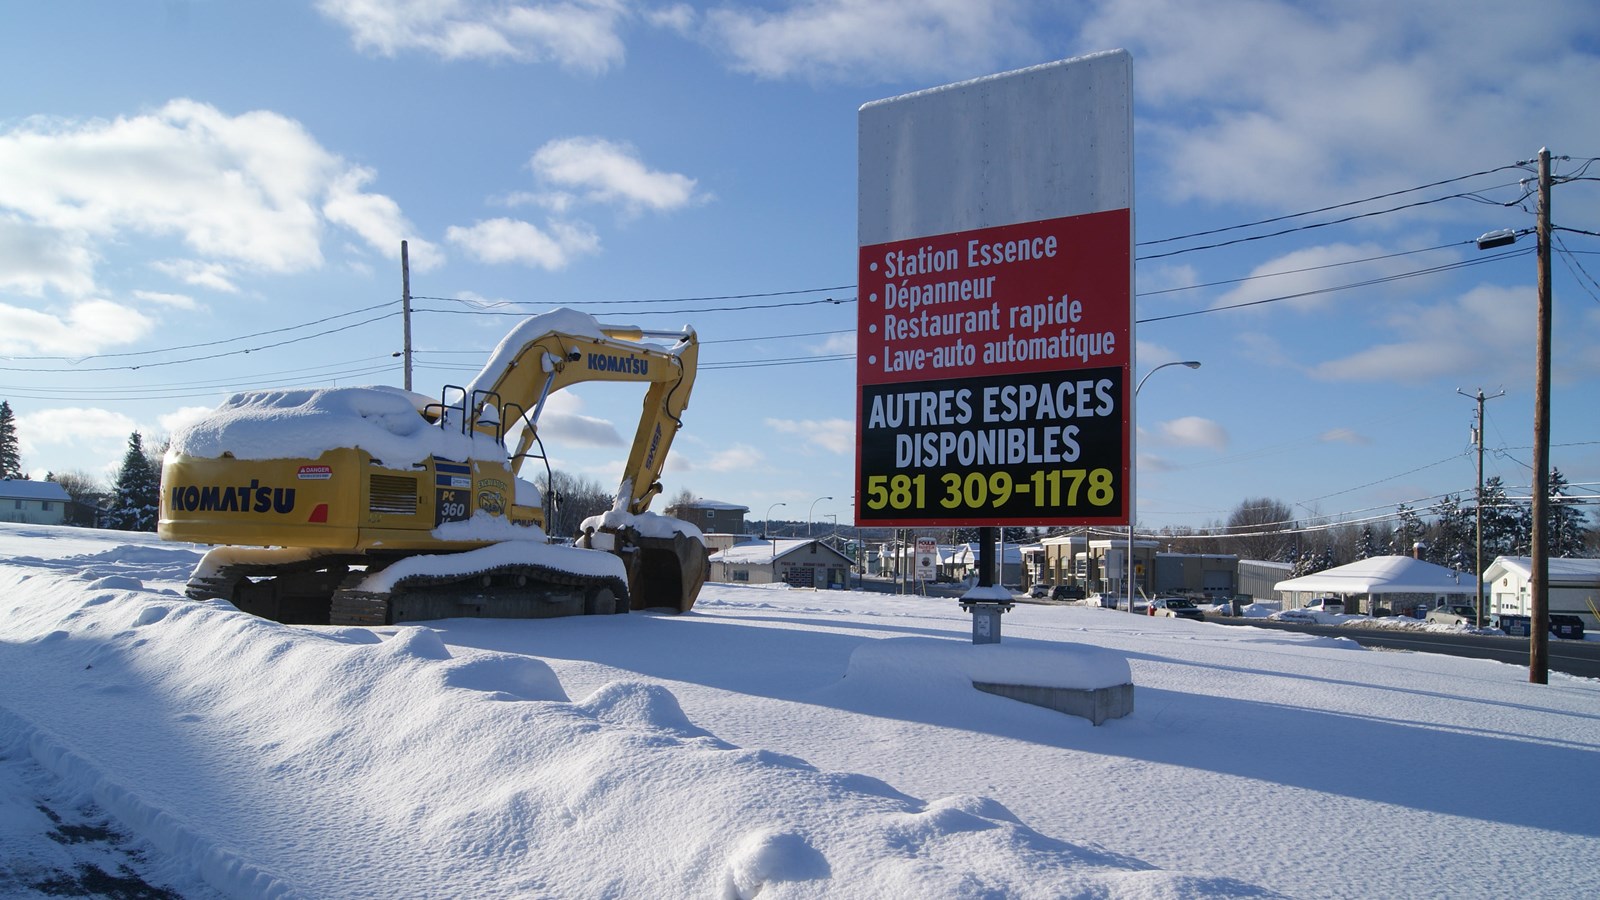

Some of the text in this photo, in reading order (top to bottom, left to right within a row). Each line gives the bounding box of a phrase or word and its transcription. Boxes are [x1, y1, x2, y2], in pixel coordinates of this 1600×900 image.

[884, 235, 1058, 279] Station Essence
[884, 275, 996, 313] Dépanneur
[883, 293, 1083, 341] Restaurant rapide
[587, 353, 649, 375] KOMATSU
[883, 327, 1115, 373] Lave-auto automatique
[868, 378, 1114, 429] AUTRES ESPACES
[895, 424, 1081, 469] DISPONIBLES
[171, 479, 297, 514] KOMATSU
[441, 502, 465, 517] 360
[442, 490, 456, 502] PC
[866, 467, 1114, 510] 581 309-1178
